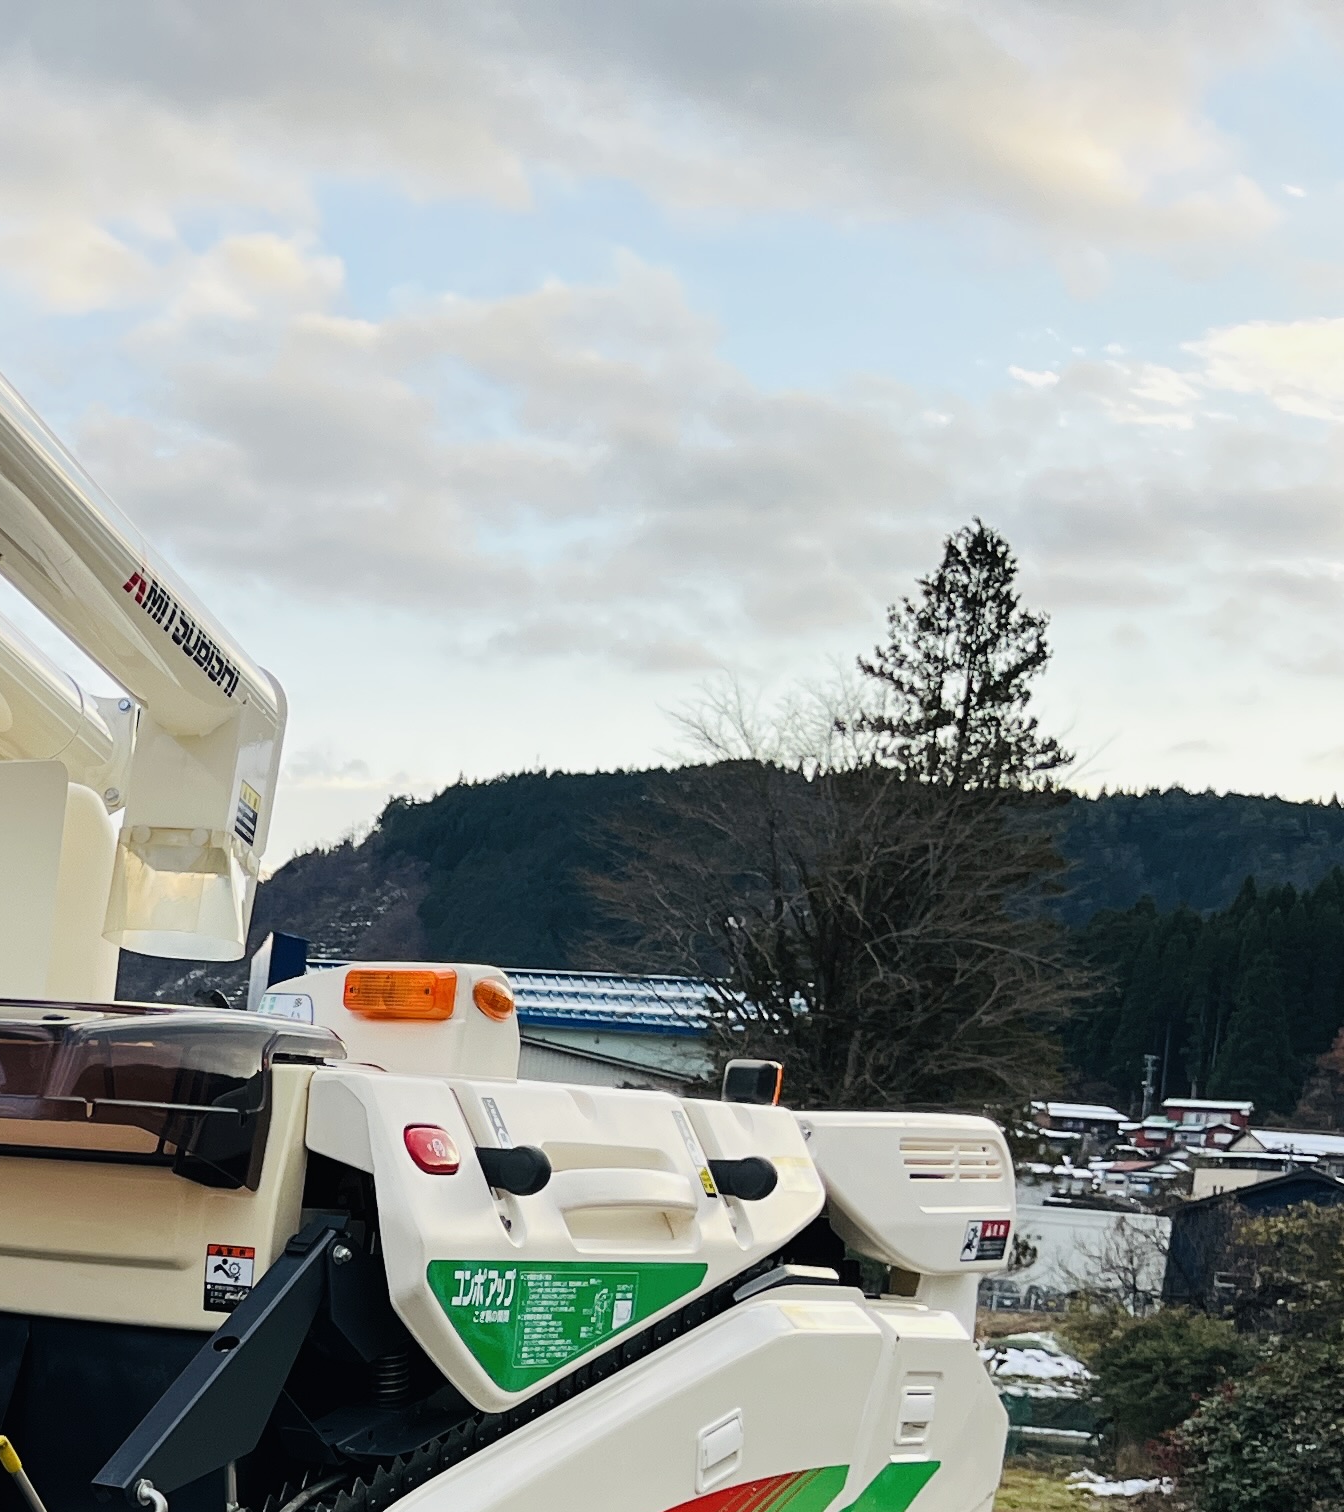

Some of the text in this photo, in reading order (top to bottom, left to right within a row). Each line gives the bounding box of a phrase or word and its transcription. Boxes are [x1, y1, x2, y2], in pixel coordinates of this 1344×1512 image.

[142, 579, 241, 698] MITSUBISHI
[451, 1268, 518, 1307] コンポアップ
